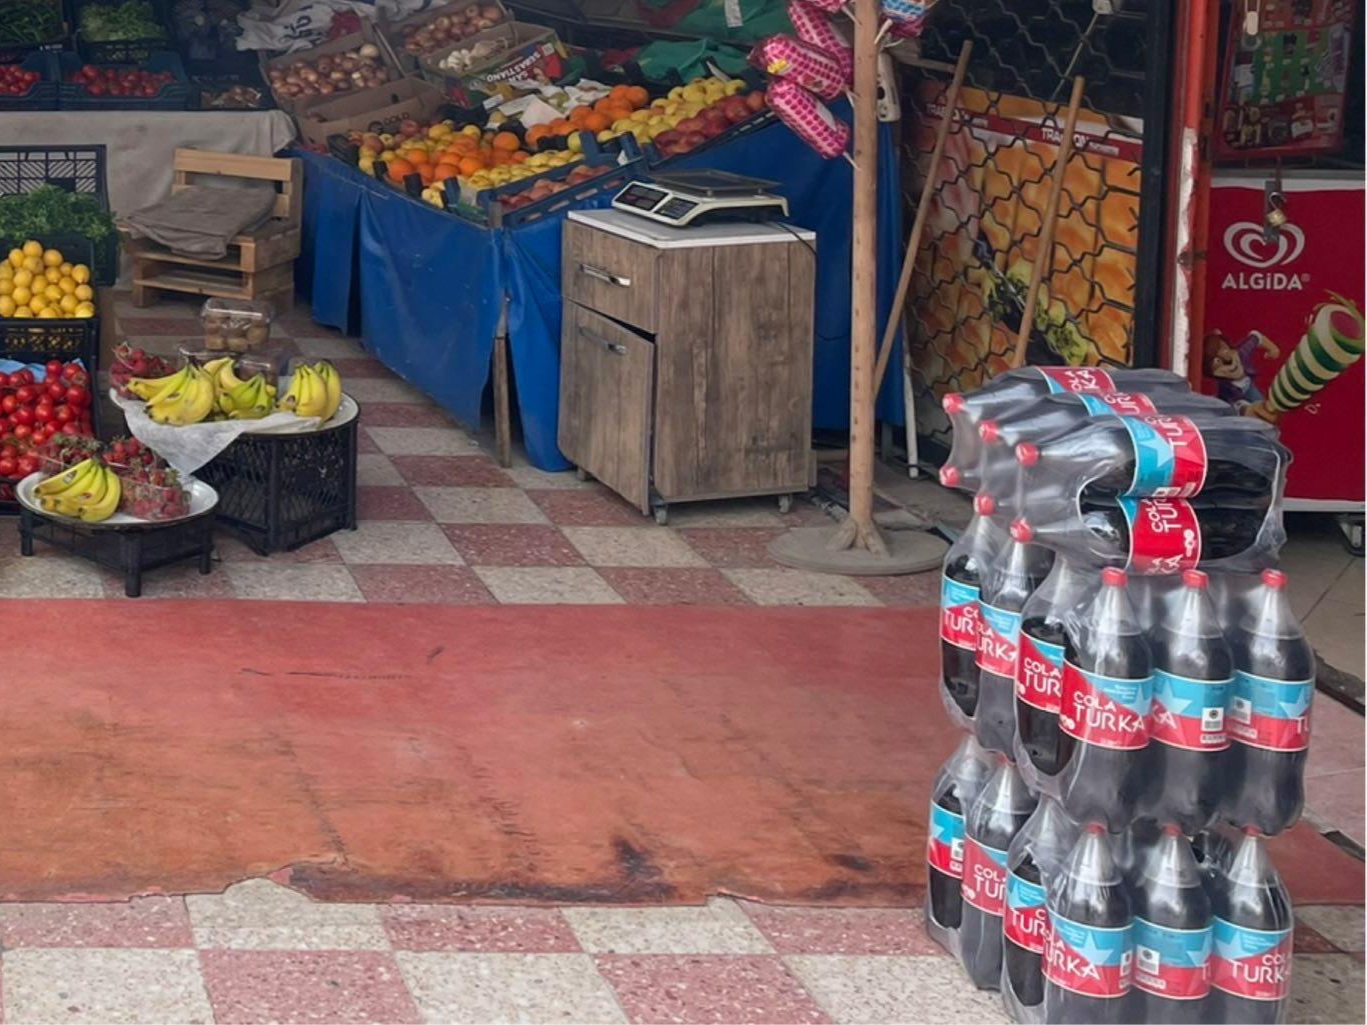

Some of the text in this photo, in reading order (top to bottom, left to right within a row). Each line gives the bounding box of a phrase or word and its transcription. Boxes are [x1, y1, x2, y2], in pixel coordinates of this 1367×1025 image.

[944, 610, 975, 636] TUR
[1023, 657, 1062, 679] COLA
[1024, 668, 1062, 698] TUR
[1073, 691, 1118, 713] COLA
[1074, 702, 1145, 733] TURKA
[1010, 907, 1047, 938] TUR
